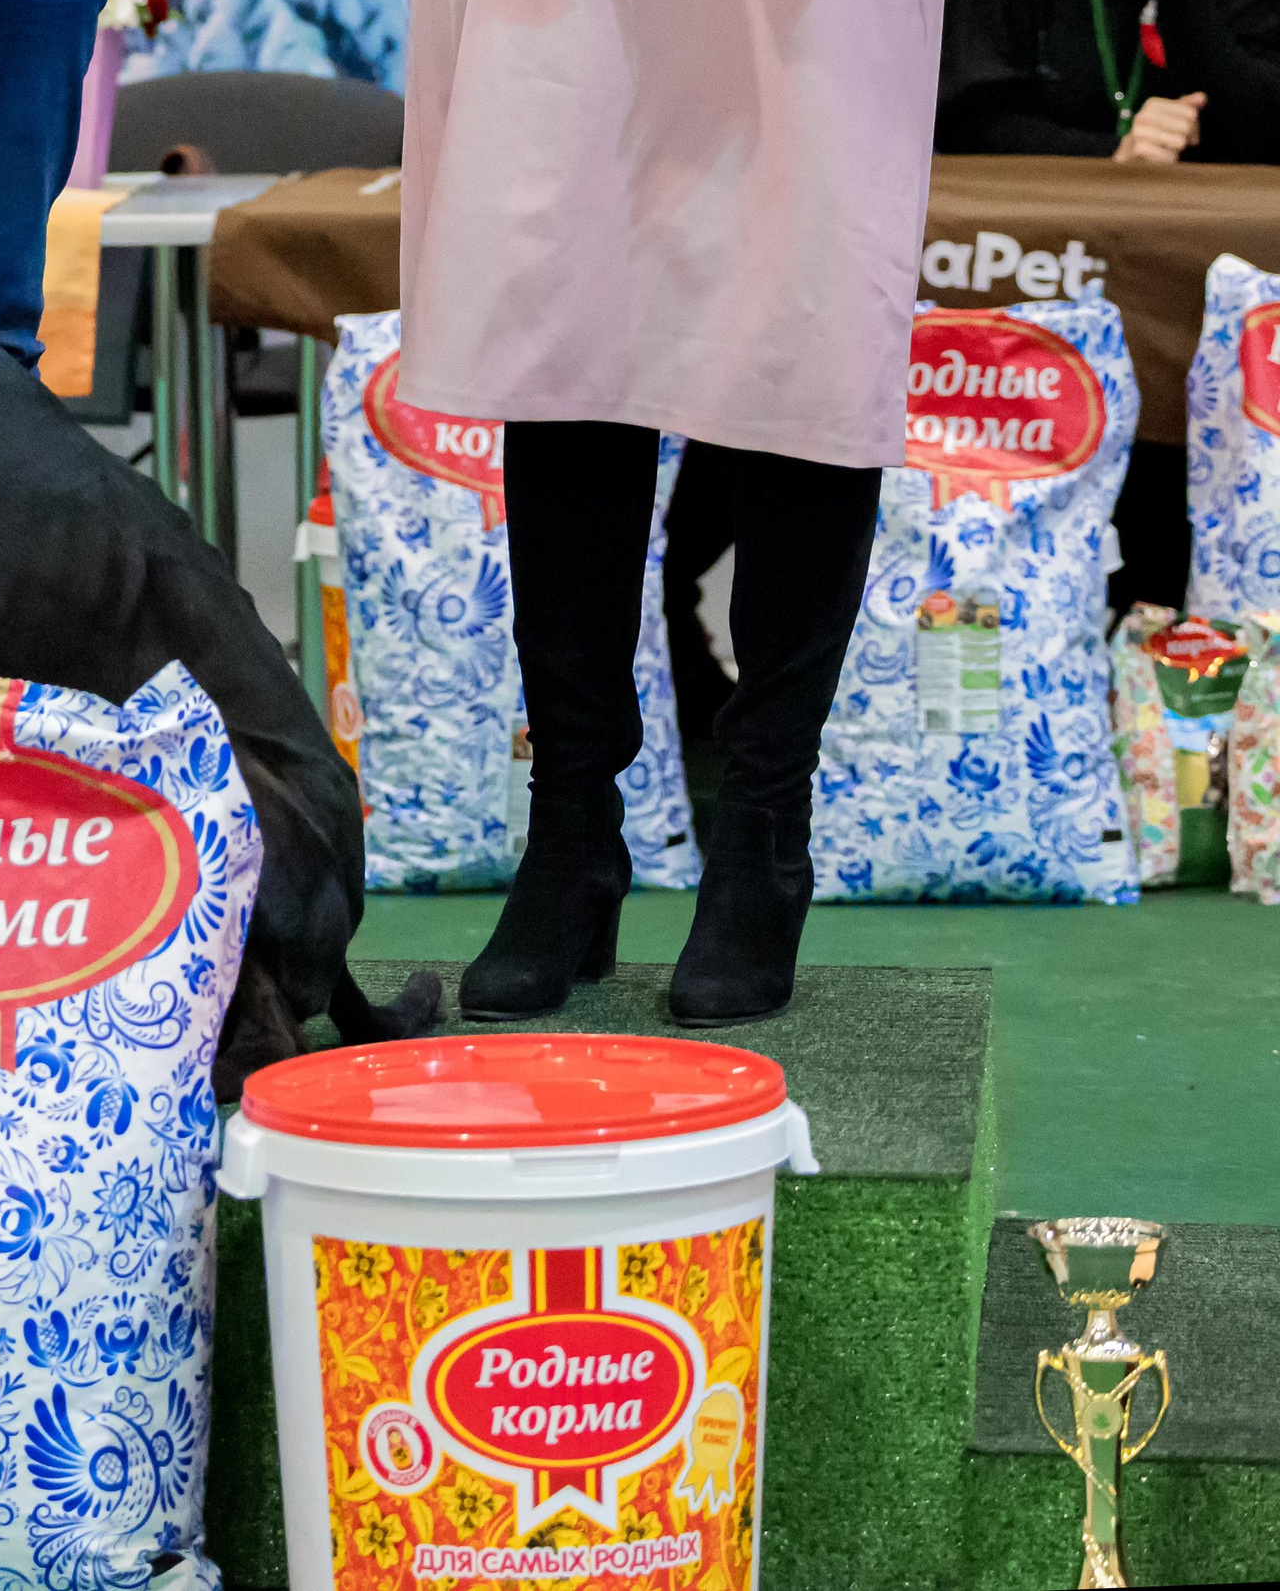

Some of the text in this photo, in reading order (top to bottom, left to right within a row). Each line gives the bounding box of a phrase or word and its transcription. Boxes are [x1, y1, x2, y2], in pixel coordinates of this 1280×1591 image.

[475, 1344, 655, 1389] Родные
[490, 1396, 642, 1445] корма
[416, 1531, 702, 1574] ДЛЯ САМЫХ РОДНЫХ
